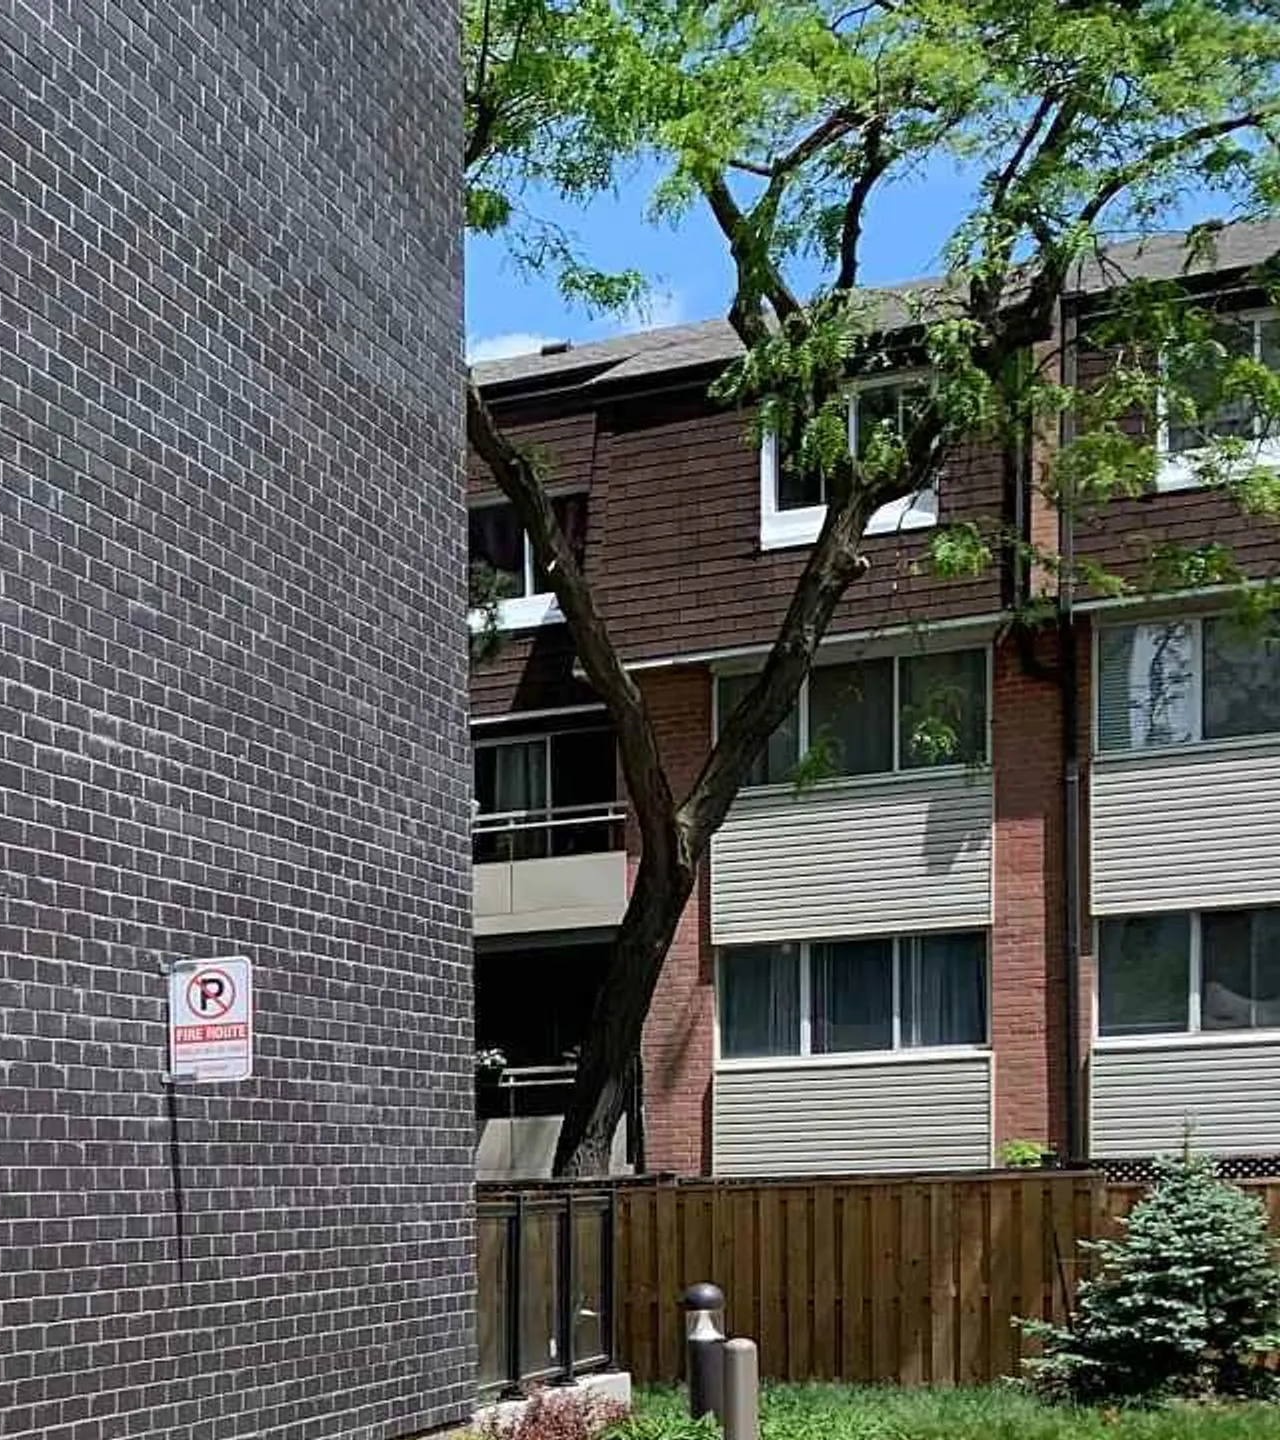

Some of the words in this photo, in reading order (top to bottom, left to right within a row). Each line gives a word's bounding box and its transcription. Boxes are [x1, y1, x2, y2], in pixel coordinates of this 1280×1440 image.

[201, 978, 224, 1011] P
[176, 1027, 204, 1041] FIRE
[206, 1025, 246, 1040] ROUTE
